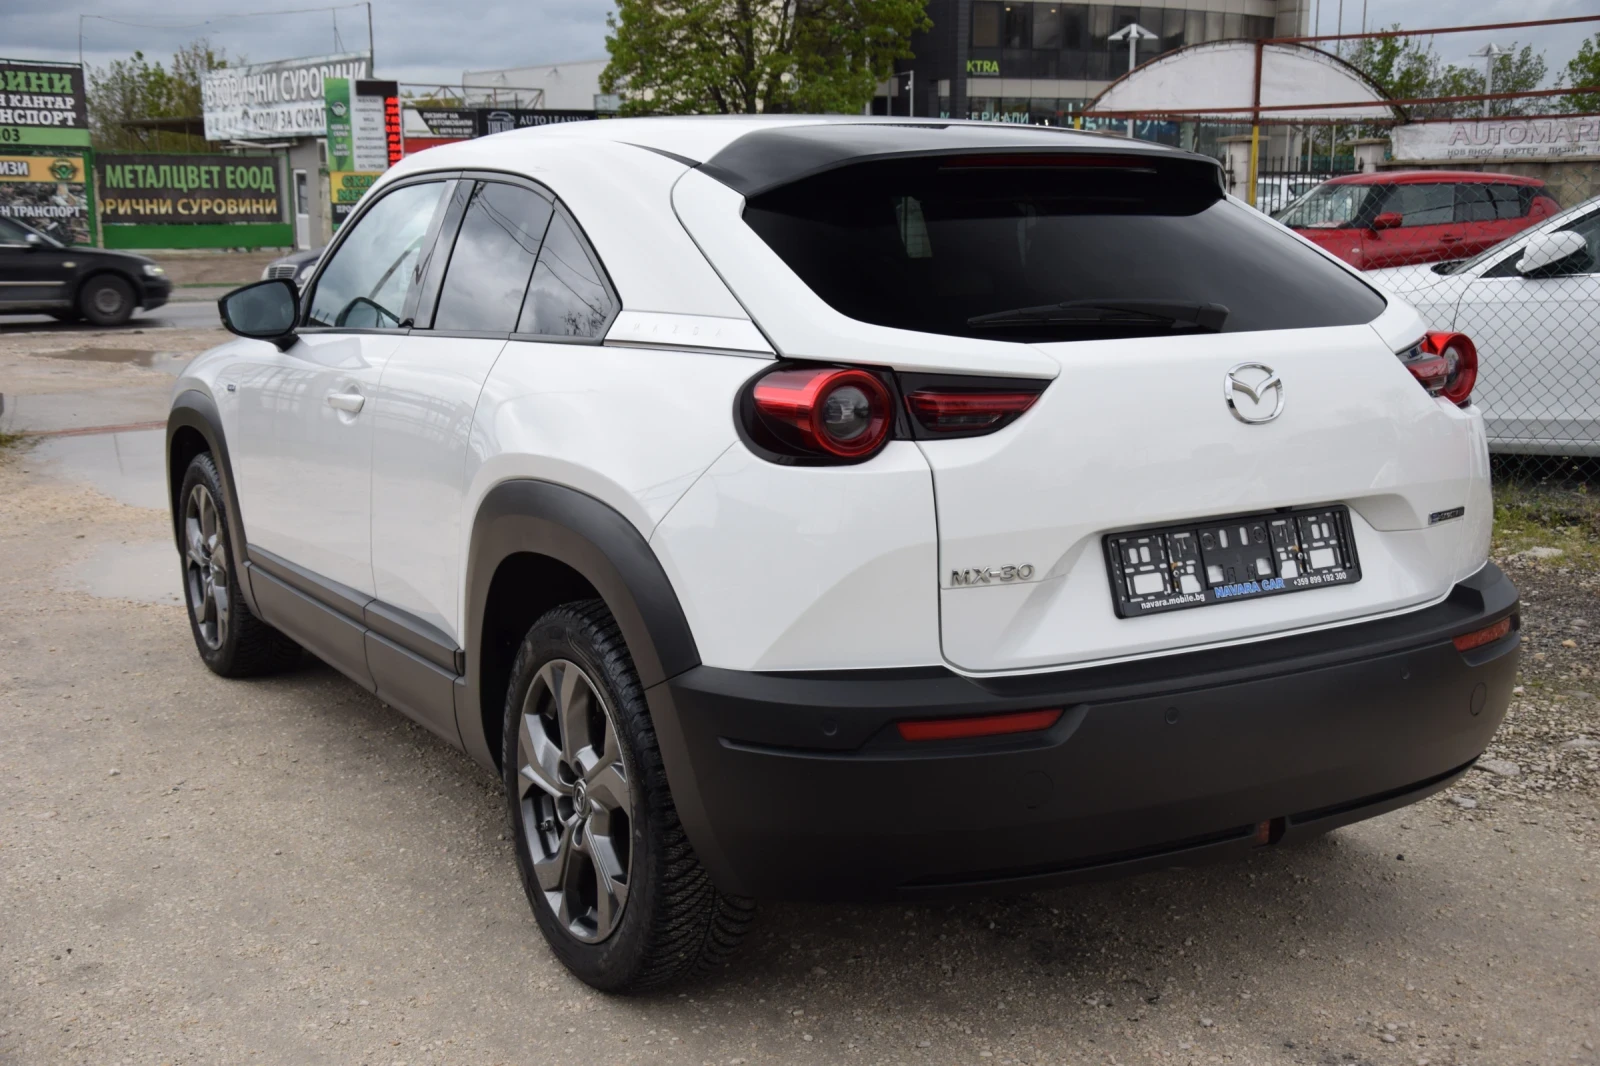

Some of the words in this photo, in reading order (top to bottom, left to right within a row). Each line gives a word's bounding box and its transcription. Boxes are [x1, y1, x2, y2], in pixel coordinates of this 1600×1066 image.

[966, 60, 999, 72] KTRA
[0, 70, 73, 94] ИНИ
[9, 94, 75, 109] КАНТАР
[281, 110, 293, 128] ЗА
[520, 115, 547, 126] AUTO
[1502, 147, 1538, 156] БАРТЕР
[104, 164, 221, 193] МЕТАЛЦВЕТ
[225, 165, 276, 193] ЕООД
[12, 205, 81, 218] ТРАНСПОРТ
[176, 199, 279, 216] СУРОВИНИ
[950, 563, 1035, 586] MX-30
[1293, 578, 1309, 586] +359
[1310, 575, 1321, 584] 899
[1323, 573, 1335, 582] 192
[1335, 571, 1347, 580] 300
[1214, 581, 1260, 599] NAVARA
[1262, 577, 1286, 590] CAR
[1141, 593, 1206, 610] navara.mobile.bg
